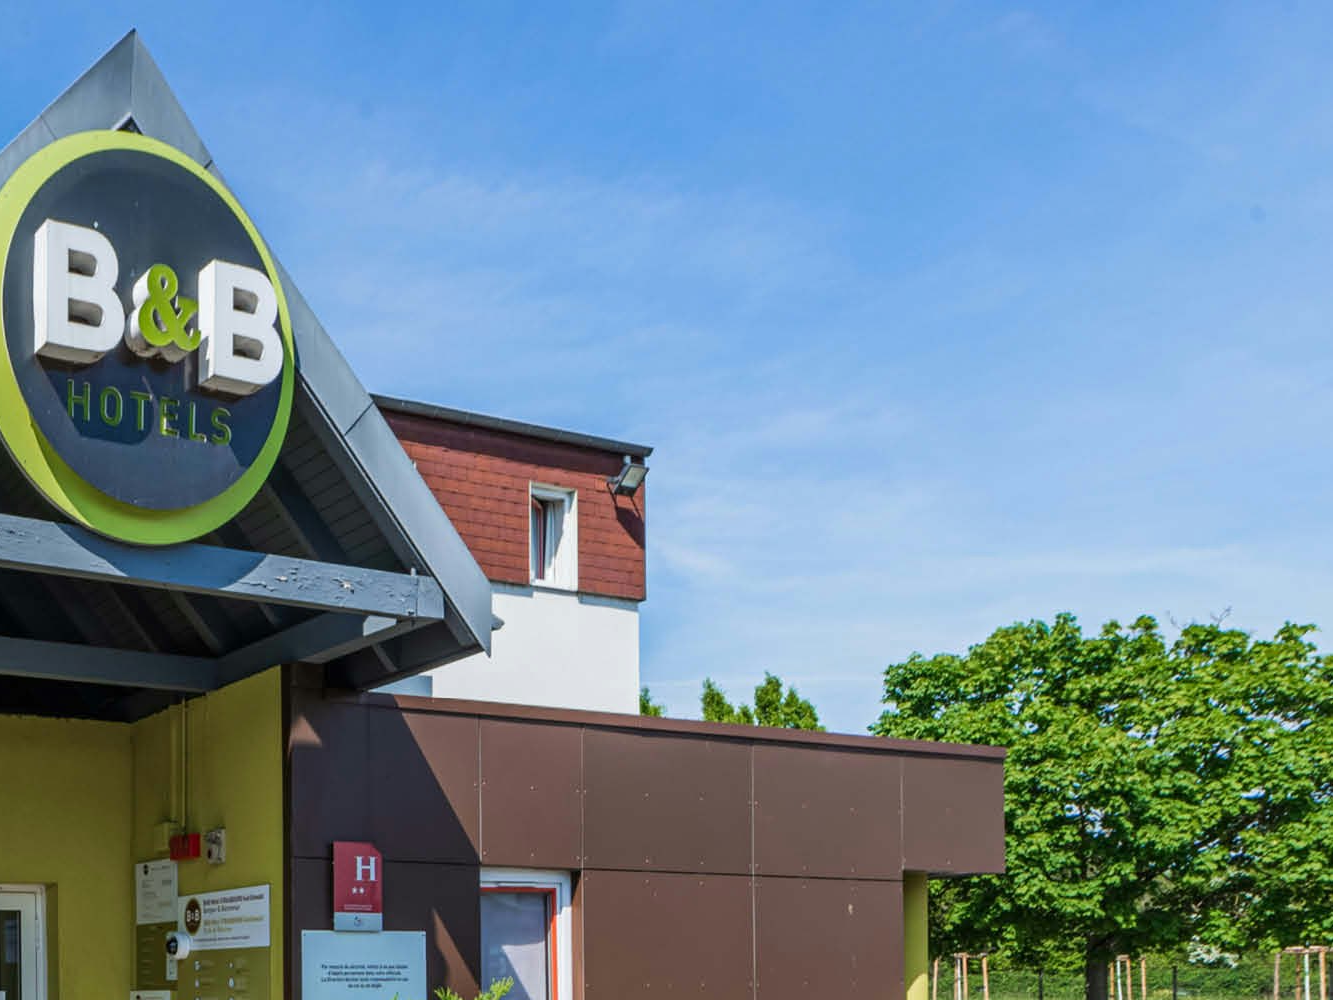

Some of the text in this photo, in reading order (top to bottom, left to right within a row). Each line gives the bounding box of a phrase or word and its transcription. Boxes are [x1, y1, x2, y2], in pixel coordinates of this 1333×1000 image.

[34, 218, 284, 394] B&B
[66, 379, 233, 446] HOTELS
[354, 855, 377, 881] H
